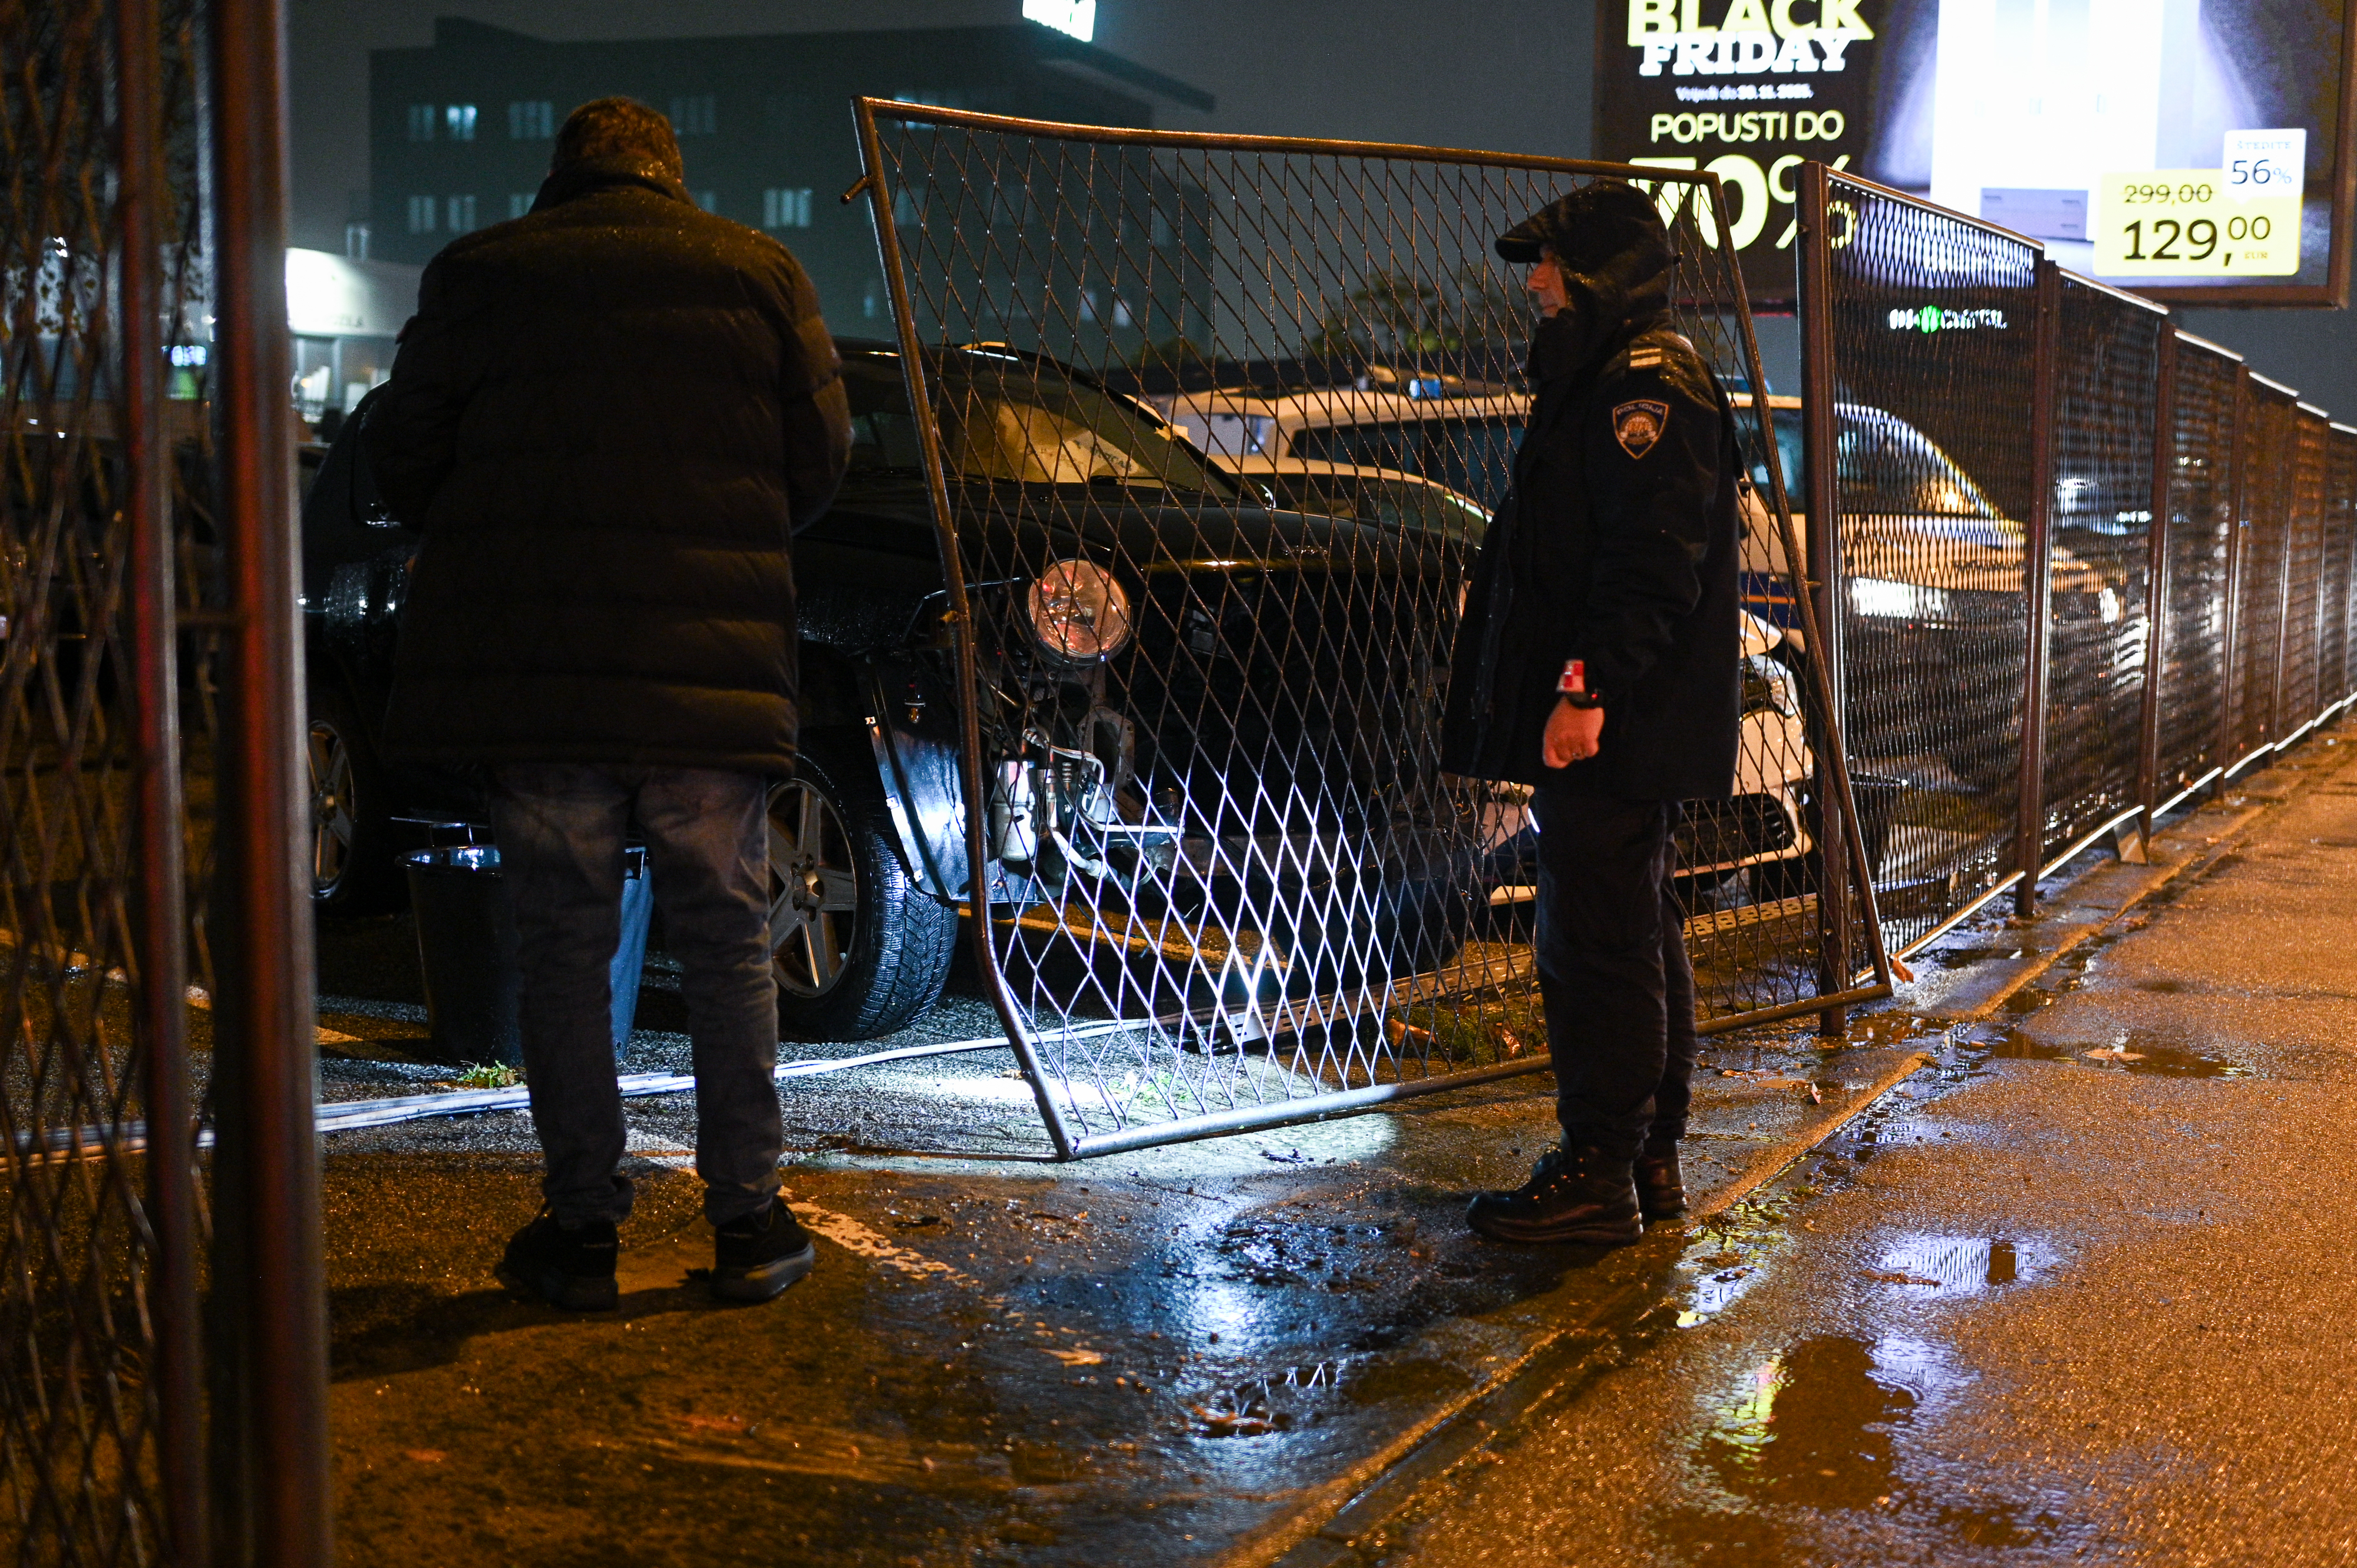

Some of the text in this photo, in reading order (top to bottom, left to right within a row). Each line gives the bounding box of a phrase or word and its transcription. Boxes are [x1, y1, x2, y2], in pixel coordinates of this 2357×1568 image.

[1628, 0, 1875, 47] BLACK
[1639, 28, 1858, 76] FRIDAY
[1652, 110, 1844, 143] POPUSTI DO
[2231, 159, 2292, 184] 56%
[2124, 183, 2213, 206] 299,00
